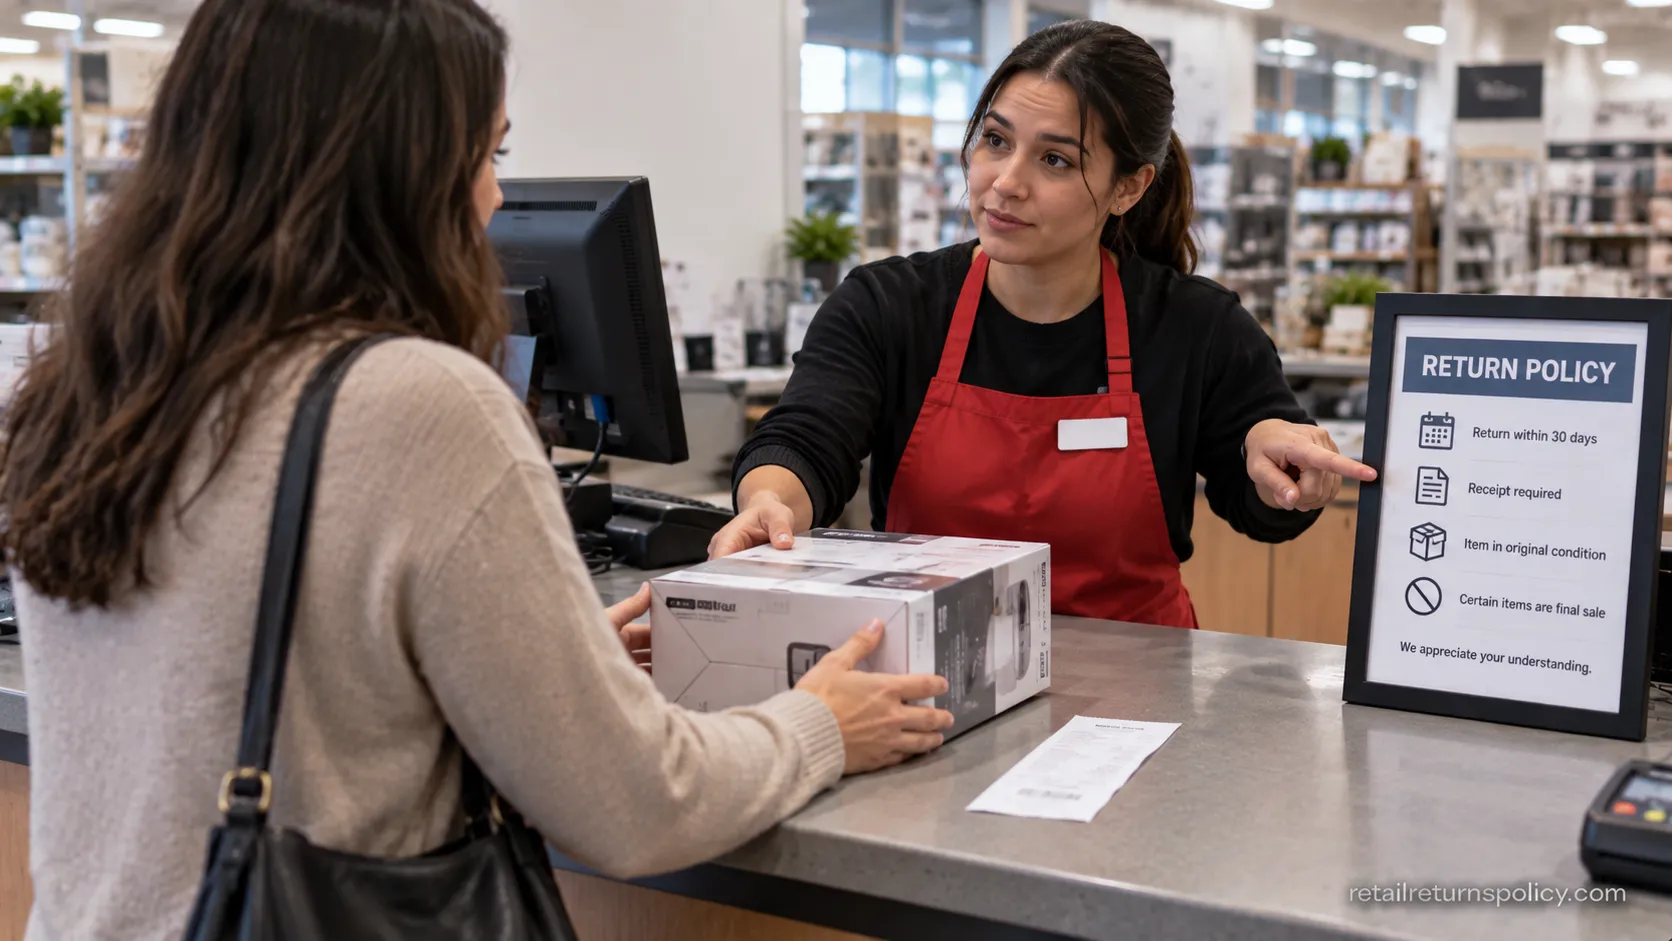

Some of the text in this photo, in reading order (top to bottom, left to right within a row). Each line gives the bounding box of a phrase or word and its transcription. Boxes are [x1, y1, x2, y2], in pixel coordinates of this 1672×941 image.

[1423, 355, 1616, 383] RETURN POLICY
[1472, 426, 1598, 446] Return within 30 days
[1468, 482, 1562, 500] Receipt required
[1464, 538, 1607, 560] Item in original condition
[1459, 593, 1606, 618] Certain items are final sale
[1400, 641, 1592, 675] We appreciate your understanding.
